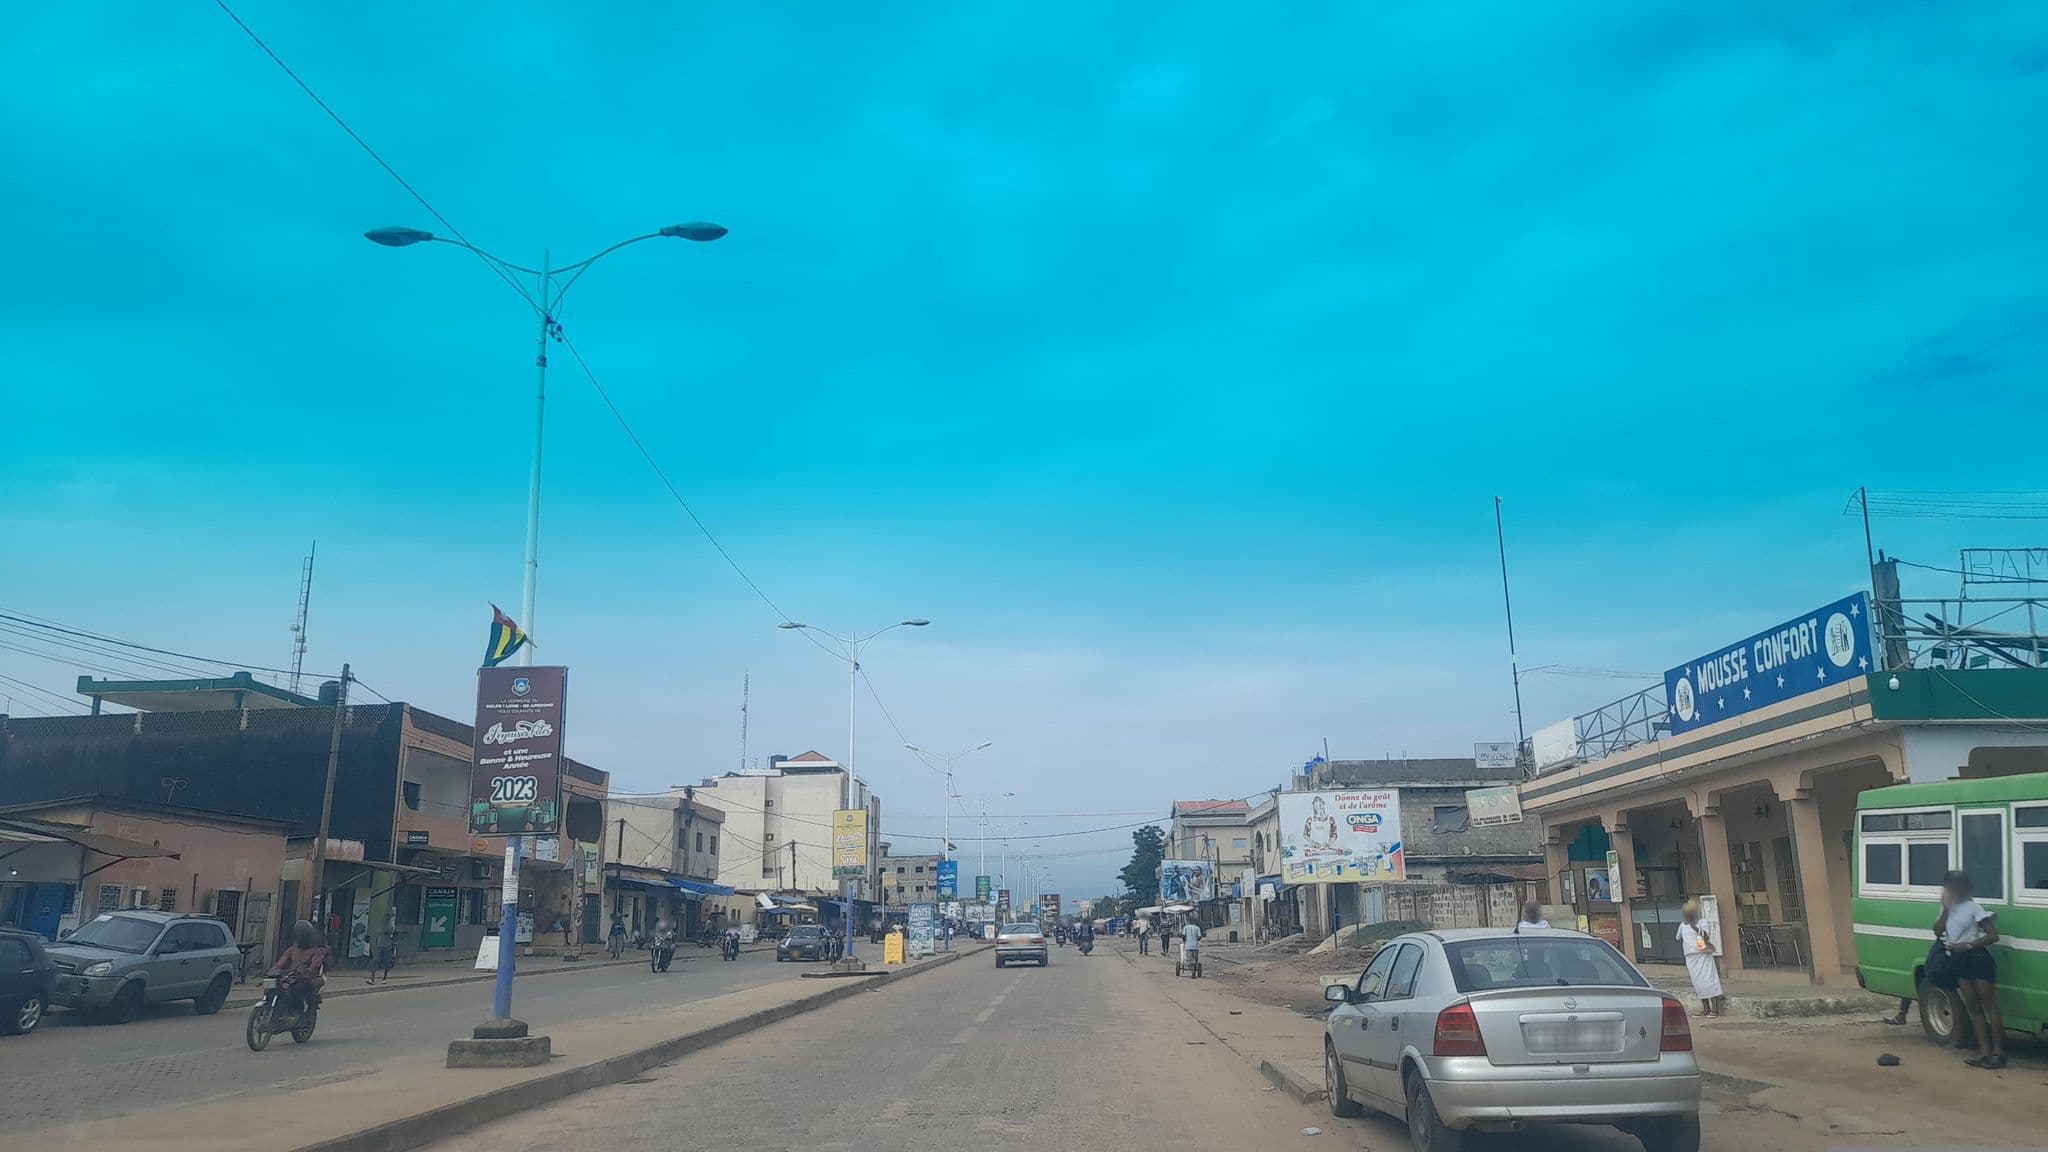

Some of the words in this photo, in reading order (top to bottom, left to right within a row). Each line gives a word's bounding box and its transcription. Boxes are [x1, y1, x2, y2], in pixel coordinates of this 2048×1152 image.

[1697, 647, 1748, 695] MOUSSE
[1753, 618, 1818, 673] CONFORT
[480, 757, 506, 765] Bonne
[515, 753, 552, 761] Heureuse
[503, 761, 529, 769] Année
[490, 776, 537, 803] 2023
[1334, 793, 1360, 802] Donne
[1348, 815, 1379, 824] ONGA
